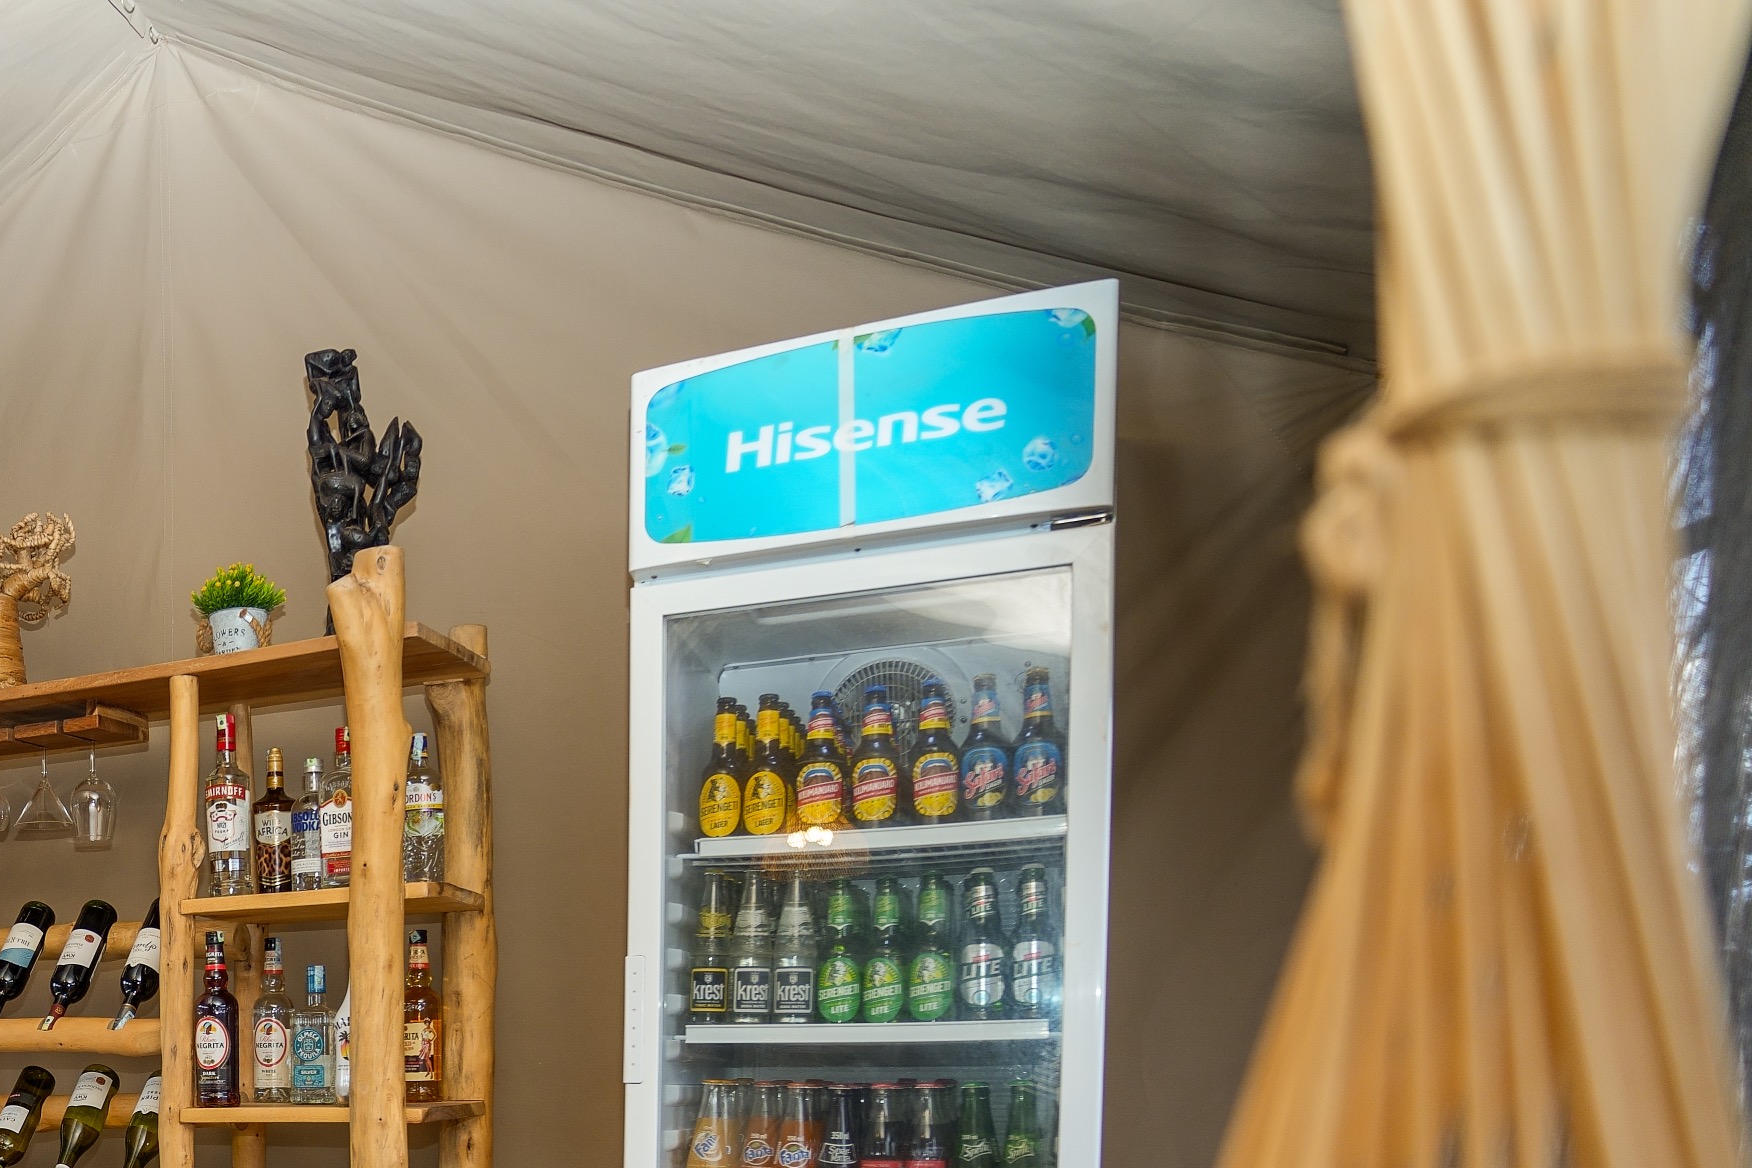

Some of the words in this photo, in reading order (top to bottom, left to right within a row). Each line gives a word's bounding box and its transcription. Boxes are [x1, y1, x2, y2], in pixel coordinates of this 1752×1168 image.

[725, 397, 1008, 474] Hisense
[213, 628, 246, 642] LOWERS
[405, 790, 437, 804] ORDON'S
[322, 811, 353, 827] GIBSON
[710, 820, 728, 830] LAGER
[755, 818, 774, 828] LAGER
[257, 826, 289, 839] AFRICA
[333, 831, 349, 839] GIN
[962, 959, 1001, 981] LITE
[1014, 956, 1053, 977] LITE
[693, 981, 725, 1000] krest
[737, 981, 769, 1001] krest
[778, 981, 811, 1001] krest
[297, 1031, 320, 1043] OLMECA
[297, 1047, 321, 1059] TEQUILA
[694, 1132, 718, 1158] Fant
[744, 1146, 774, 1160] Fanta
[778, 1148, 811, 1165] Fanta
